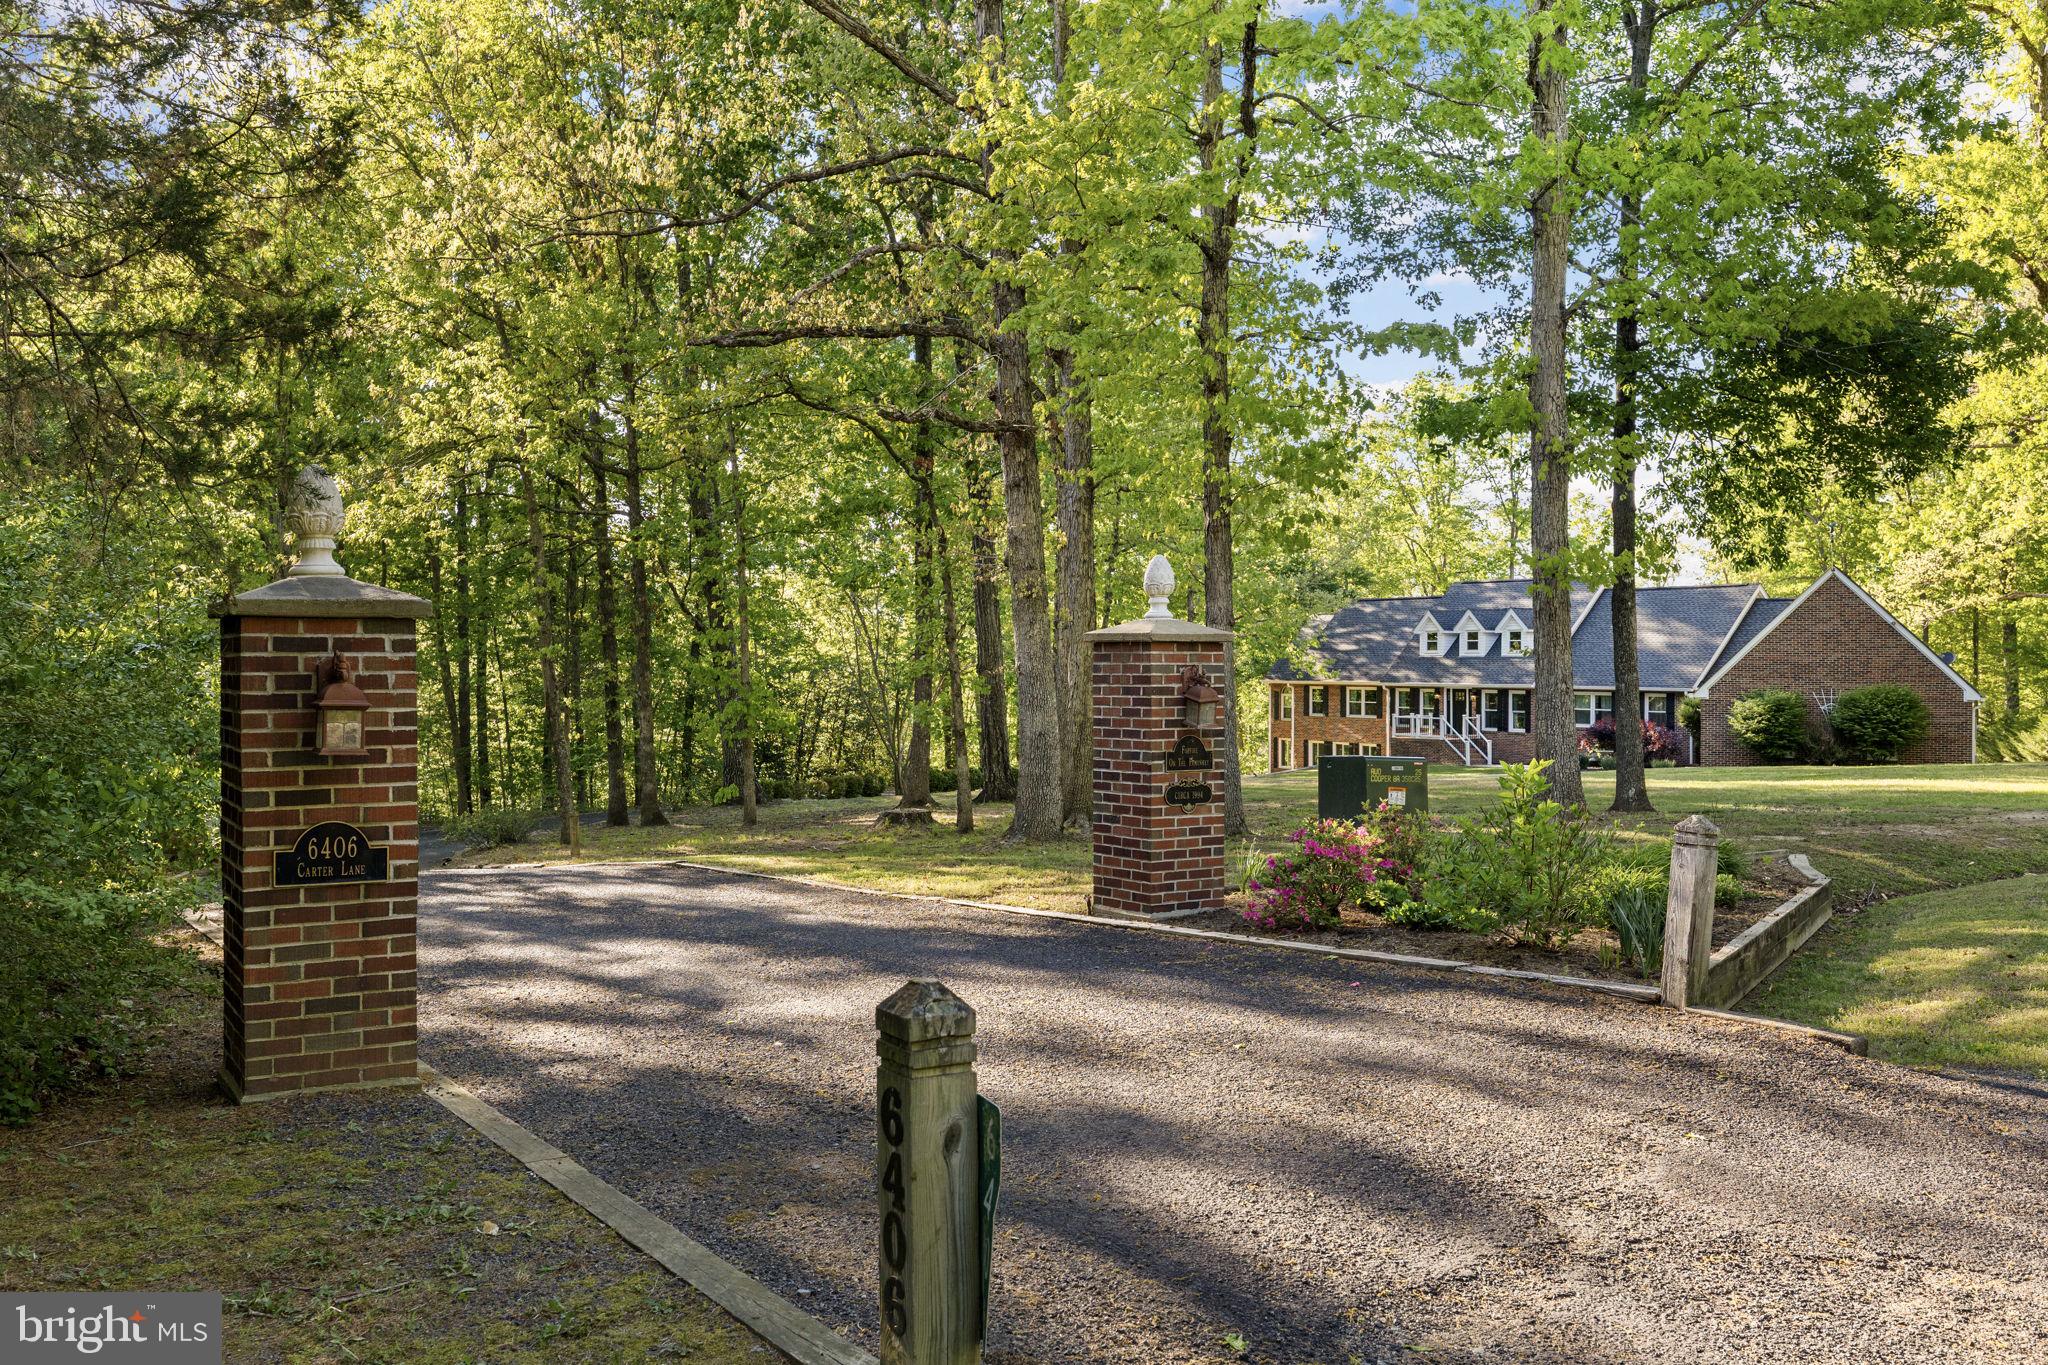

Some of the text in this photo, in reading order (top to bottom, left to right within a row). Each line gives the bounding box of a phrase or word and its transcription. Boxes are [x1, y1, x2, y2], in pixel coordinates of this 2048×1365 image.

[308, 835, 357, 860] 6406
[297, 860, 366, 878] CARTER LANE
[881, 1086, 907, 1338] 6406
